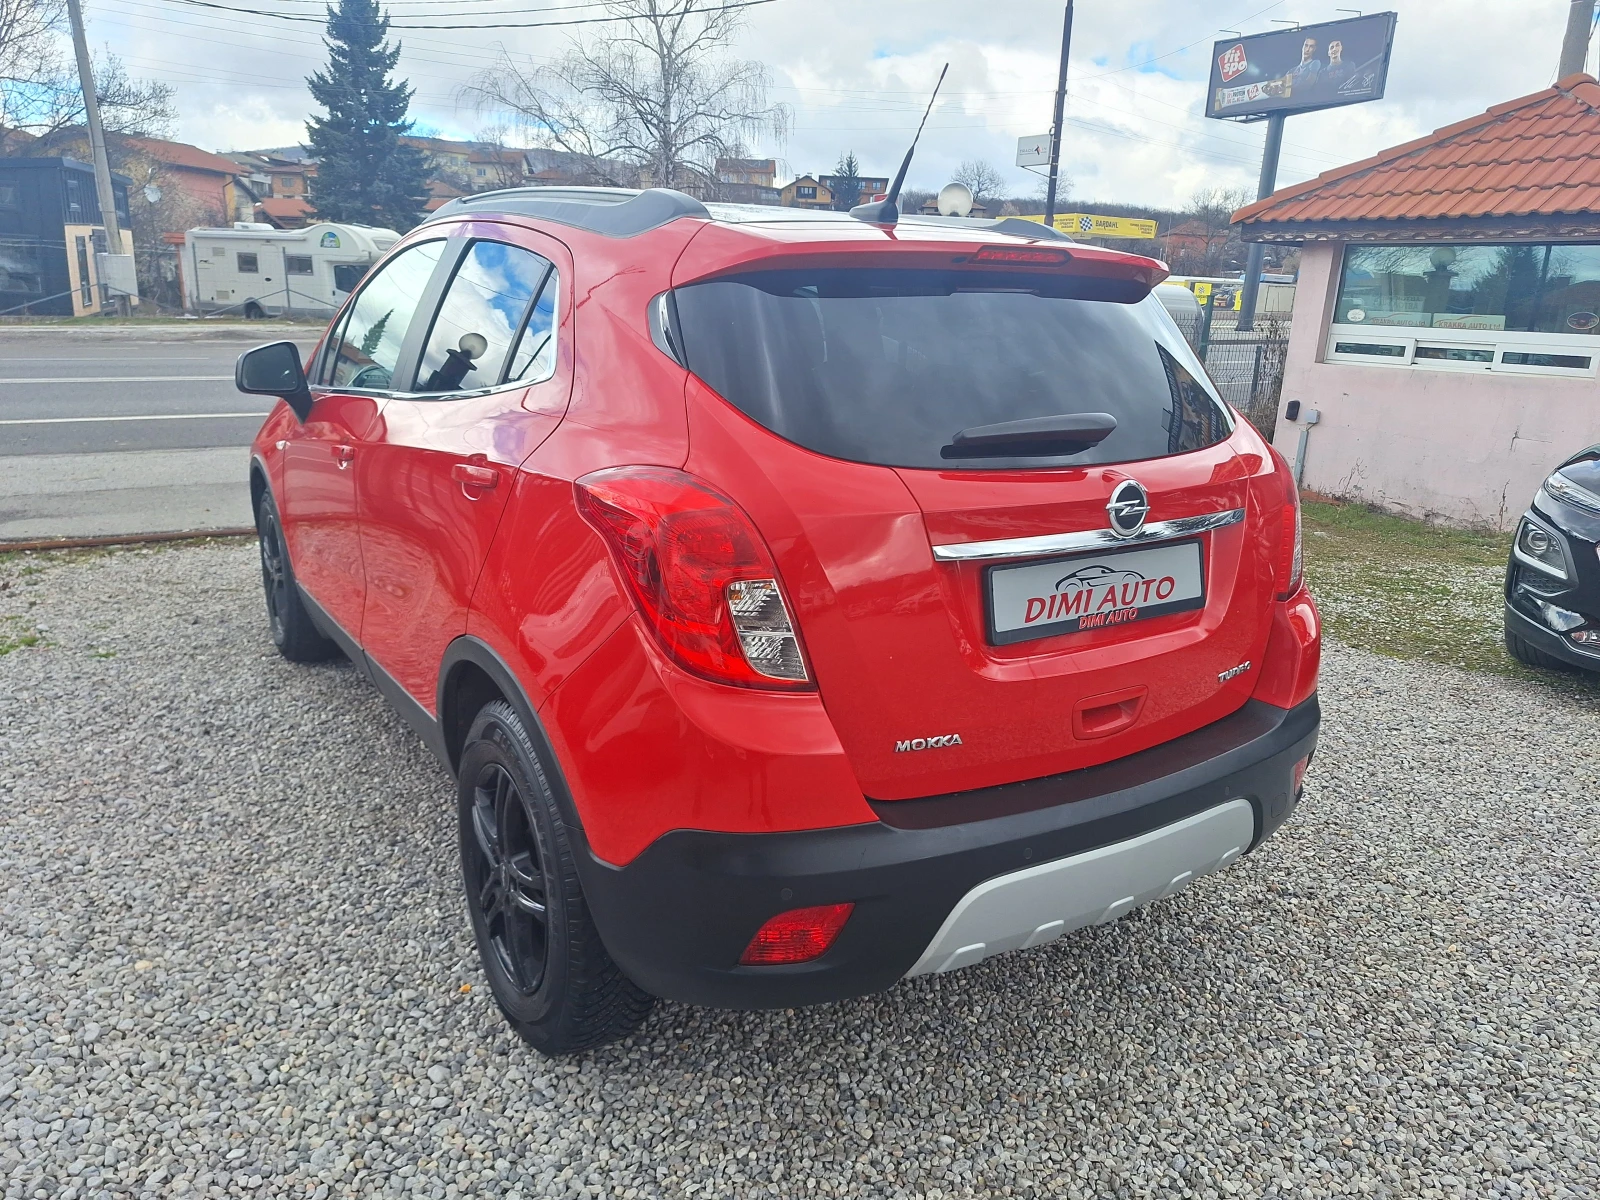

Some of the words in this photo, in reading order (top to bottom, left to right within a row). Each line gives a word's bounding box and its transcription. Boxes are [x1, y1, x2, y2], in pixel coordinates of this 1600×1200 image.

[1224, 49, 1241, 64] fit
[1223, 61, 1247, 76] spo
[1095, 219, 1119, 230] BARDAHL
[1371, 318, 1396, 327] KRAKRA
[1438, 321, 1467, 329] KRAKRA
[1024, 589, 1093, 623] DIMI
[1096, 576, 1175, 611] AUTO
[1078, 611, 1107, 629] DIMI
[1106, 607, 1138, 625] AUTO
[894, 733, 963, 753] MOKKA
